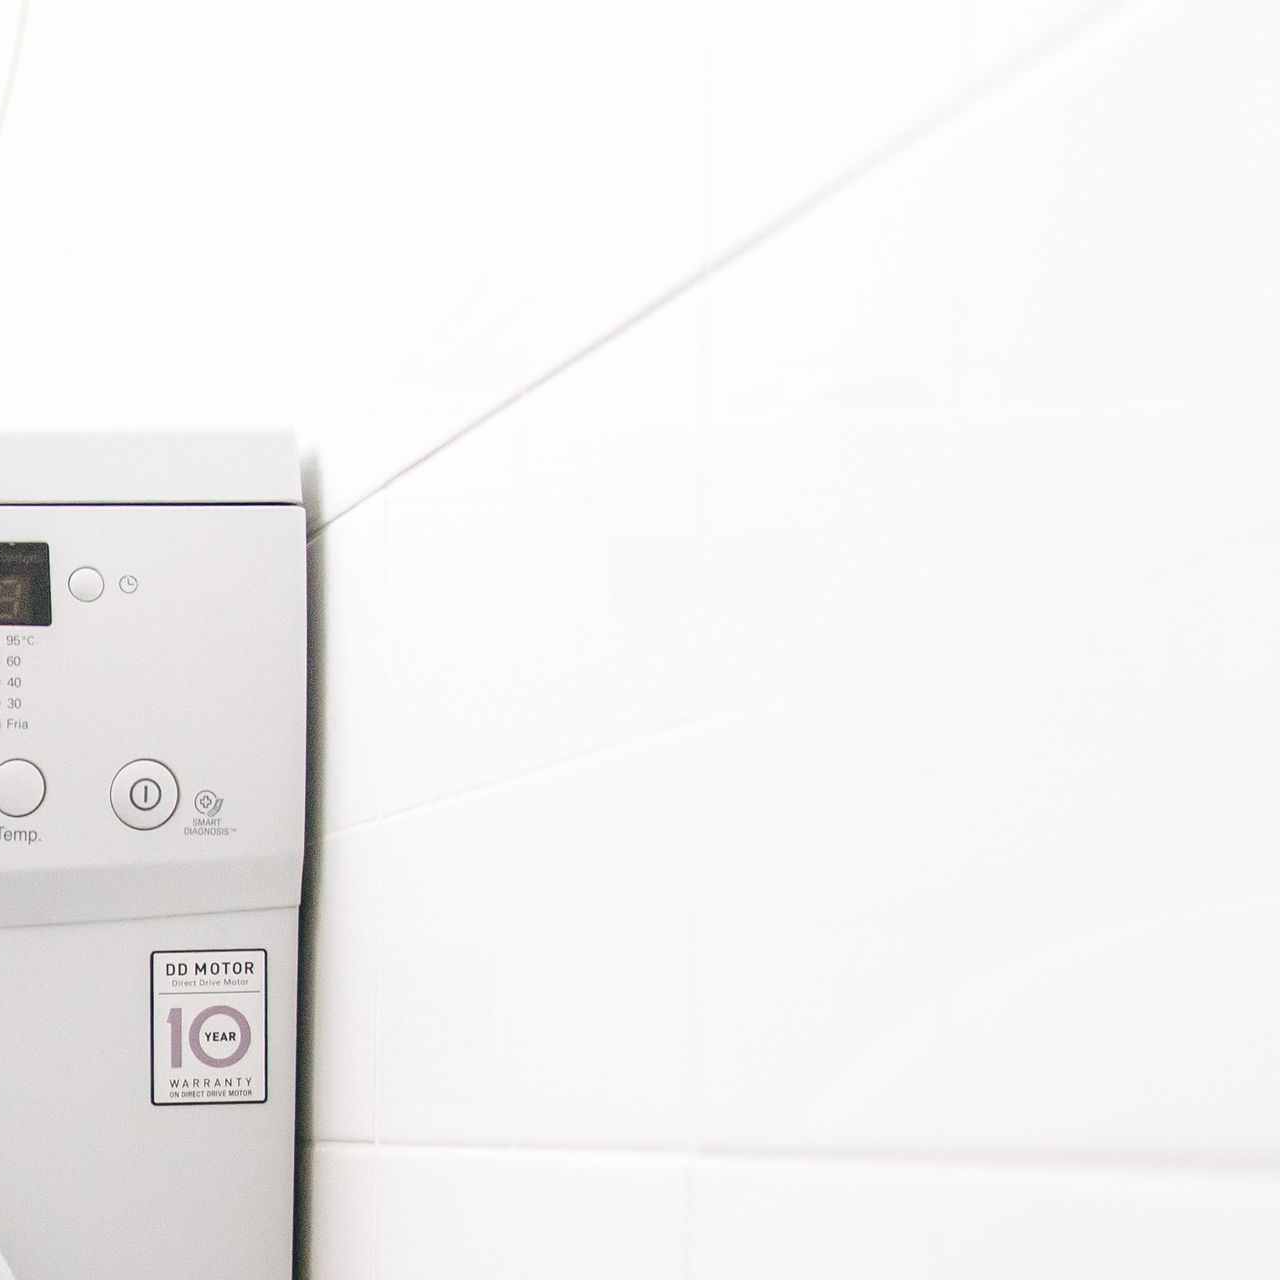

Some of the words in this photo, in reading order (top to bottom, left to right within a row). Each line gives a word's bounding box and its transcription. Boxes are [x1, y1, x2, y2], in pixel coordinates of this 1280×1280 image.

[6, 655, 21, 667] 60
[7, 677, 22, 688] 40
[7, 698, 22, 709] 30
[192, 818, 222, 827] SMART
[166, 963, 188, 976] DD
[195, 961, 254, 975] MOTOR
[172, 979, 197, 987] Direct
[199, 979, 221, 987] Drive
[223, 978, 249, 986] Motor
[166, 1005, 252, 1069] 10
[204, 1031, 237, 1042] YEAR
[169, 1077, 253, 1088] WARRANTY
[181, 1090, 204, 1098] DIRECT
[206, 1089, 227, 1097] DRIVE
[228, 1089, 253, 1097] MOTOR
